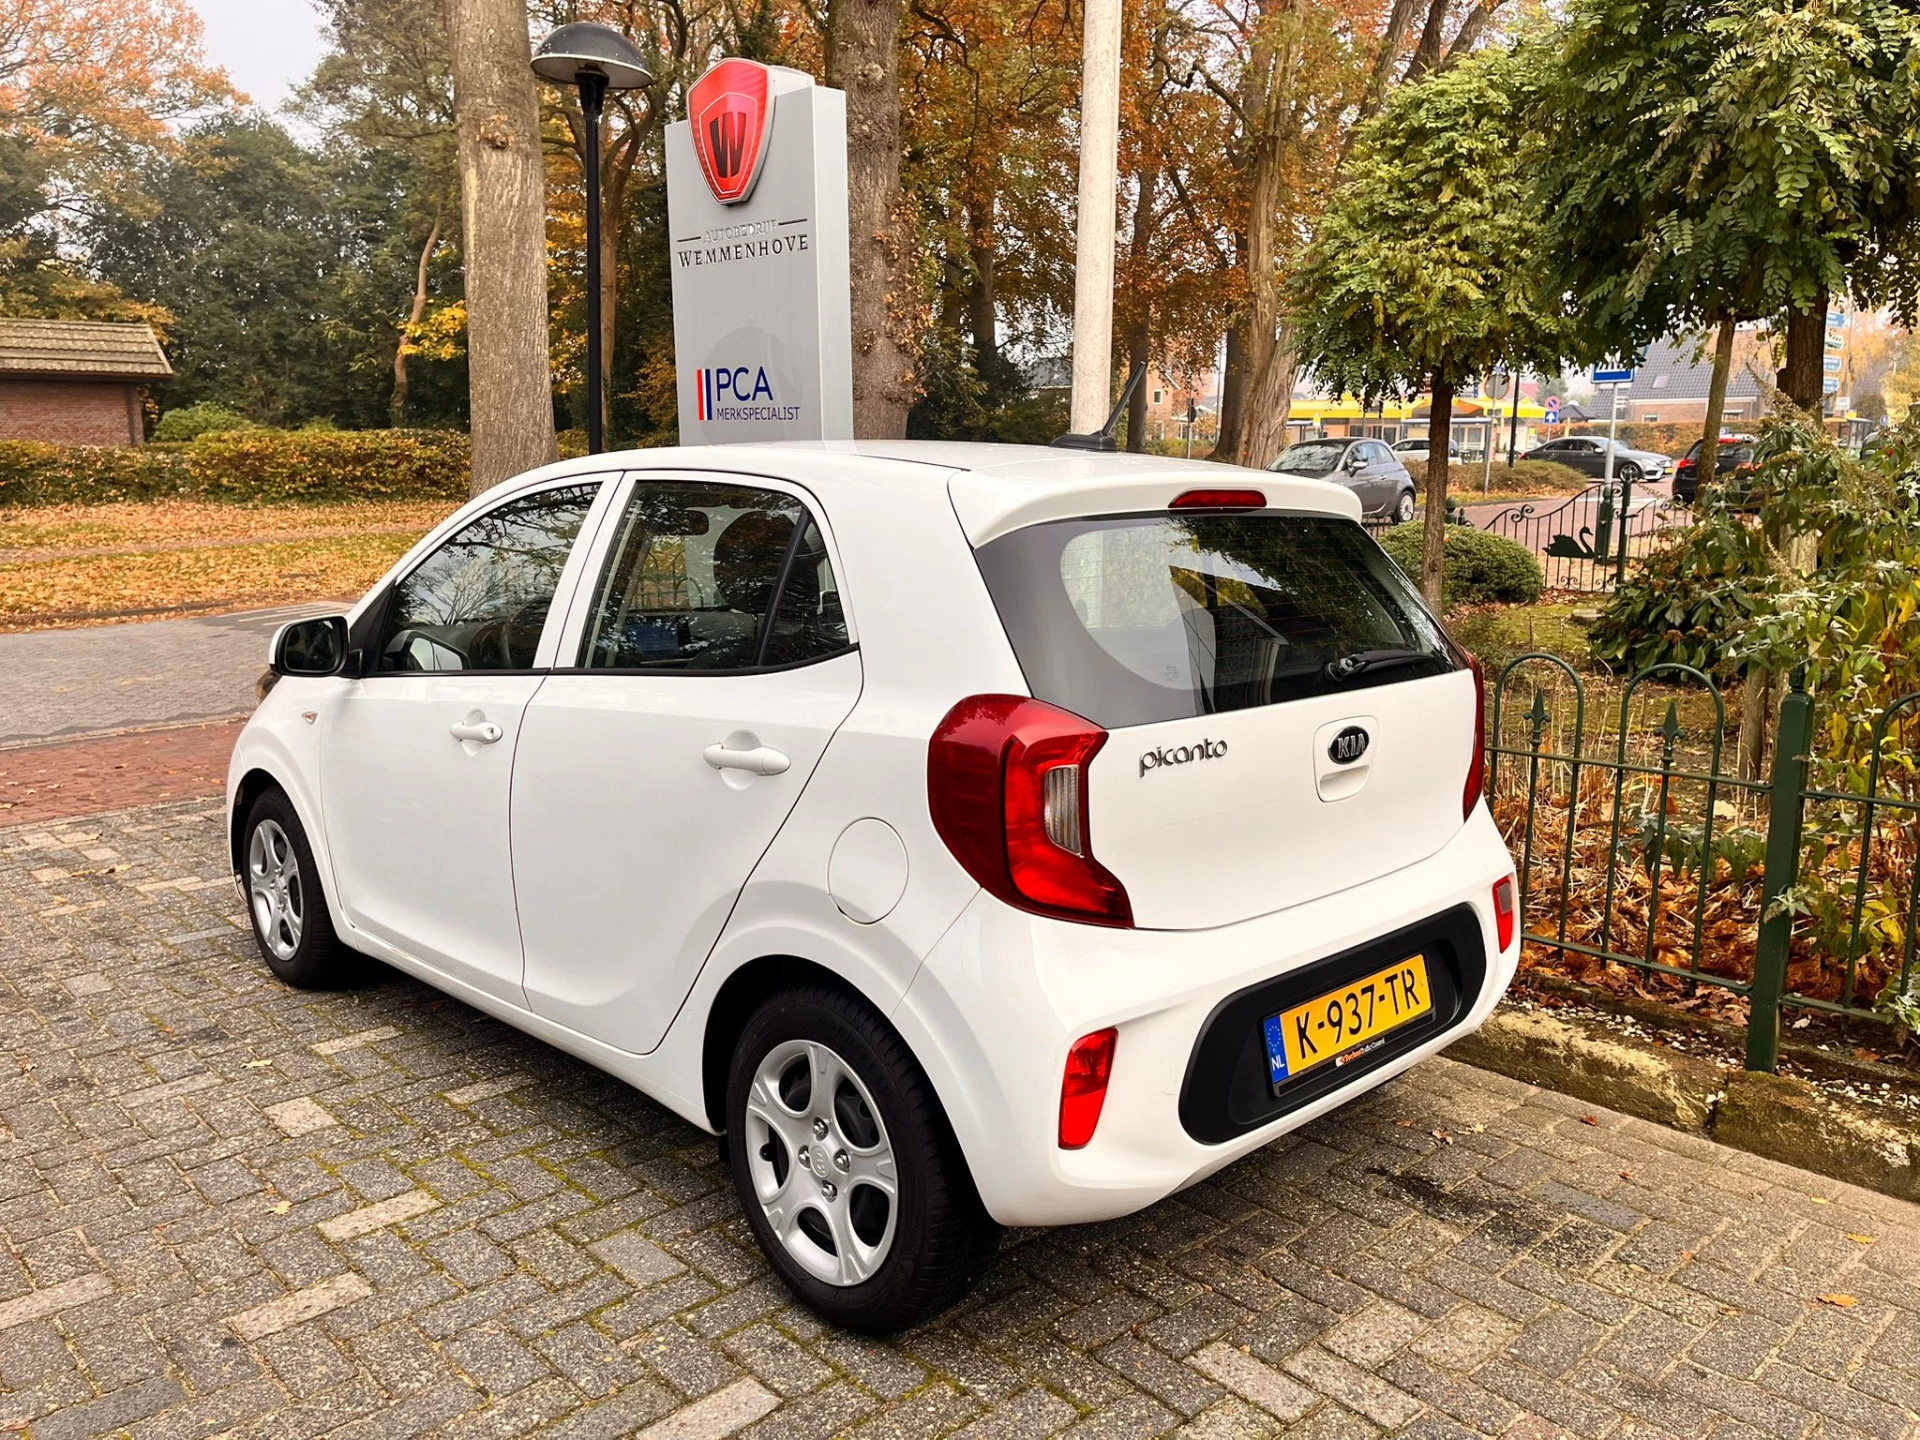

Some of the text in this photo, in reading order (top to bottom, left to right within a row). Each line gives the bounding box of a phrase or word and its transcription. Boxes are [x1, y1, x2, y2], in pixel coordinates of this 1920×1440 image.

[709, 111, 746, 178] W
[703, 219, 777, 243] AUTOBEDRIJF
[677, 234, 808, 268] WEMMENHOVE
[716, 366, 774, 401] PCA
[716, 406, 800, 421] MERKSPECIALIST
[1139, 738, 1228, 778] picanto
[1337, 733, 1366, 759] KIA
[1296, 968, 1420, 1060] K-937-TR
[1271, 1056, 1285, 1071] NL
